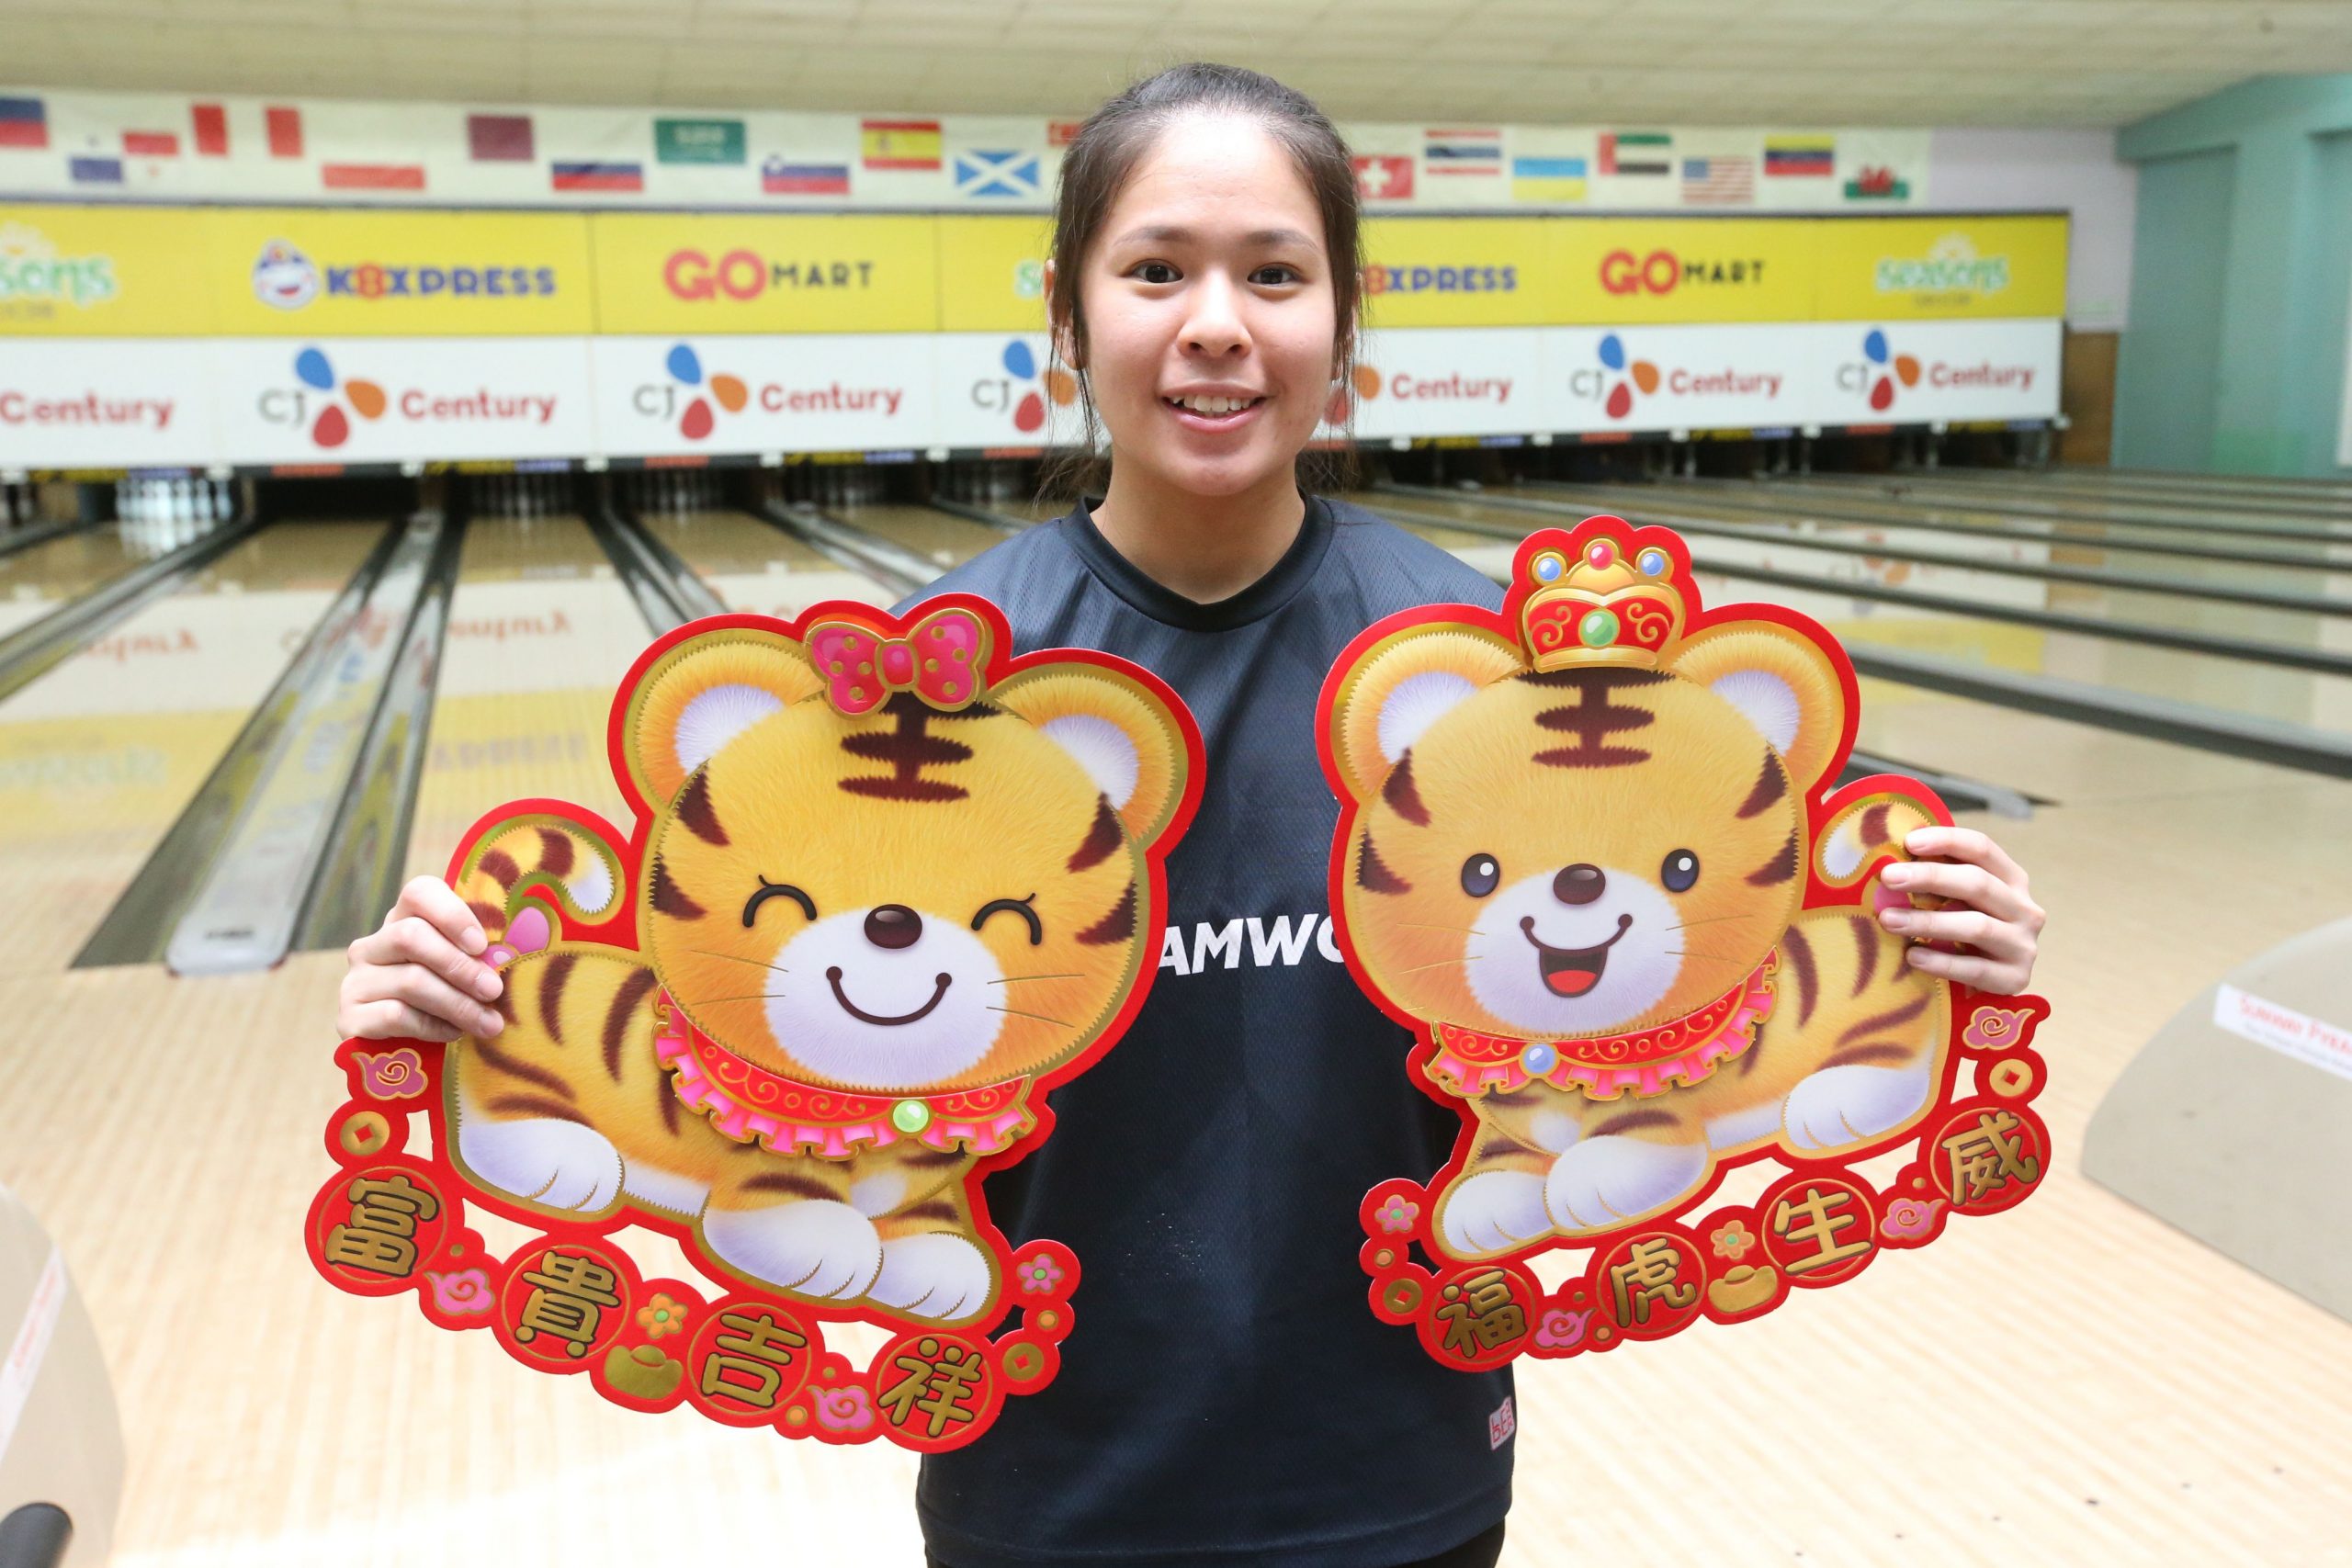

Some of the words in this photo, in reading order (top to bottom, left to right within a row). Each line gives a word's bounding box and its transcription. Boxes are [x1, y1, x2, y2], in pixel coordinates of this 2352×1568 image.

[663, 249, 766, 300] GO
[771, 262, 874, 288] MART
[1600, 250, 1679, 296] GO
[1682, 260, 1764, 283] MART
[971, 378, 1010, 412] CJ
[1390, 373, 1512, 404] Century
[1570, 369, 1602, 400] CJ
[1668, 368, 1782, 399] Century
[1837, 364, 1868, 393] CJ
[1929, 362, 2035, 392] Century
[0, 391, 174, 430] Century
[258, 389, 307, 426] CJ
[400, 389, 557, 425] Century
[632, 384, 677, 420] CJ
[759, 383, 903, 416] Century
